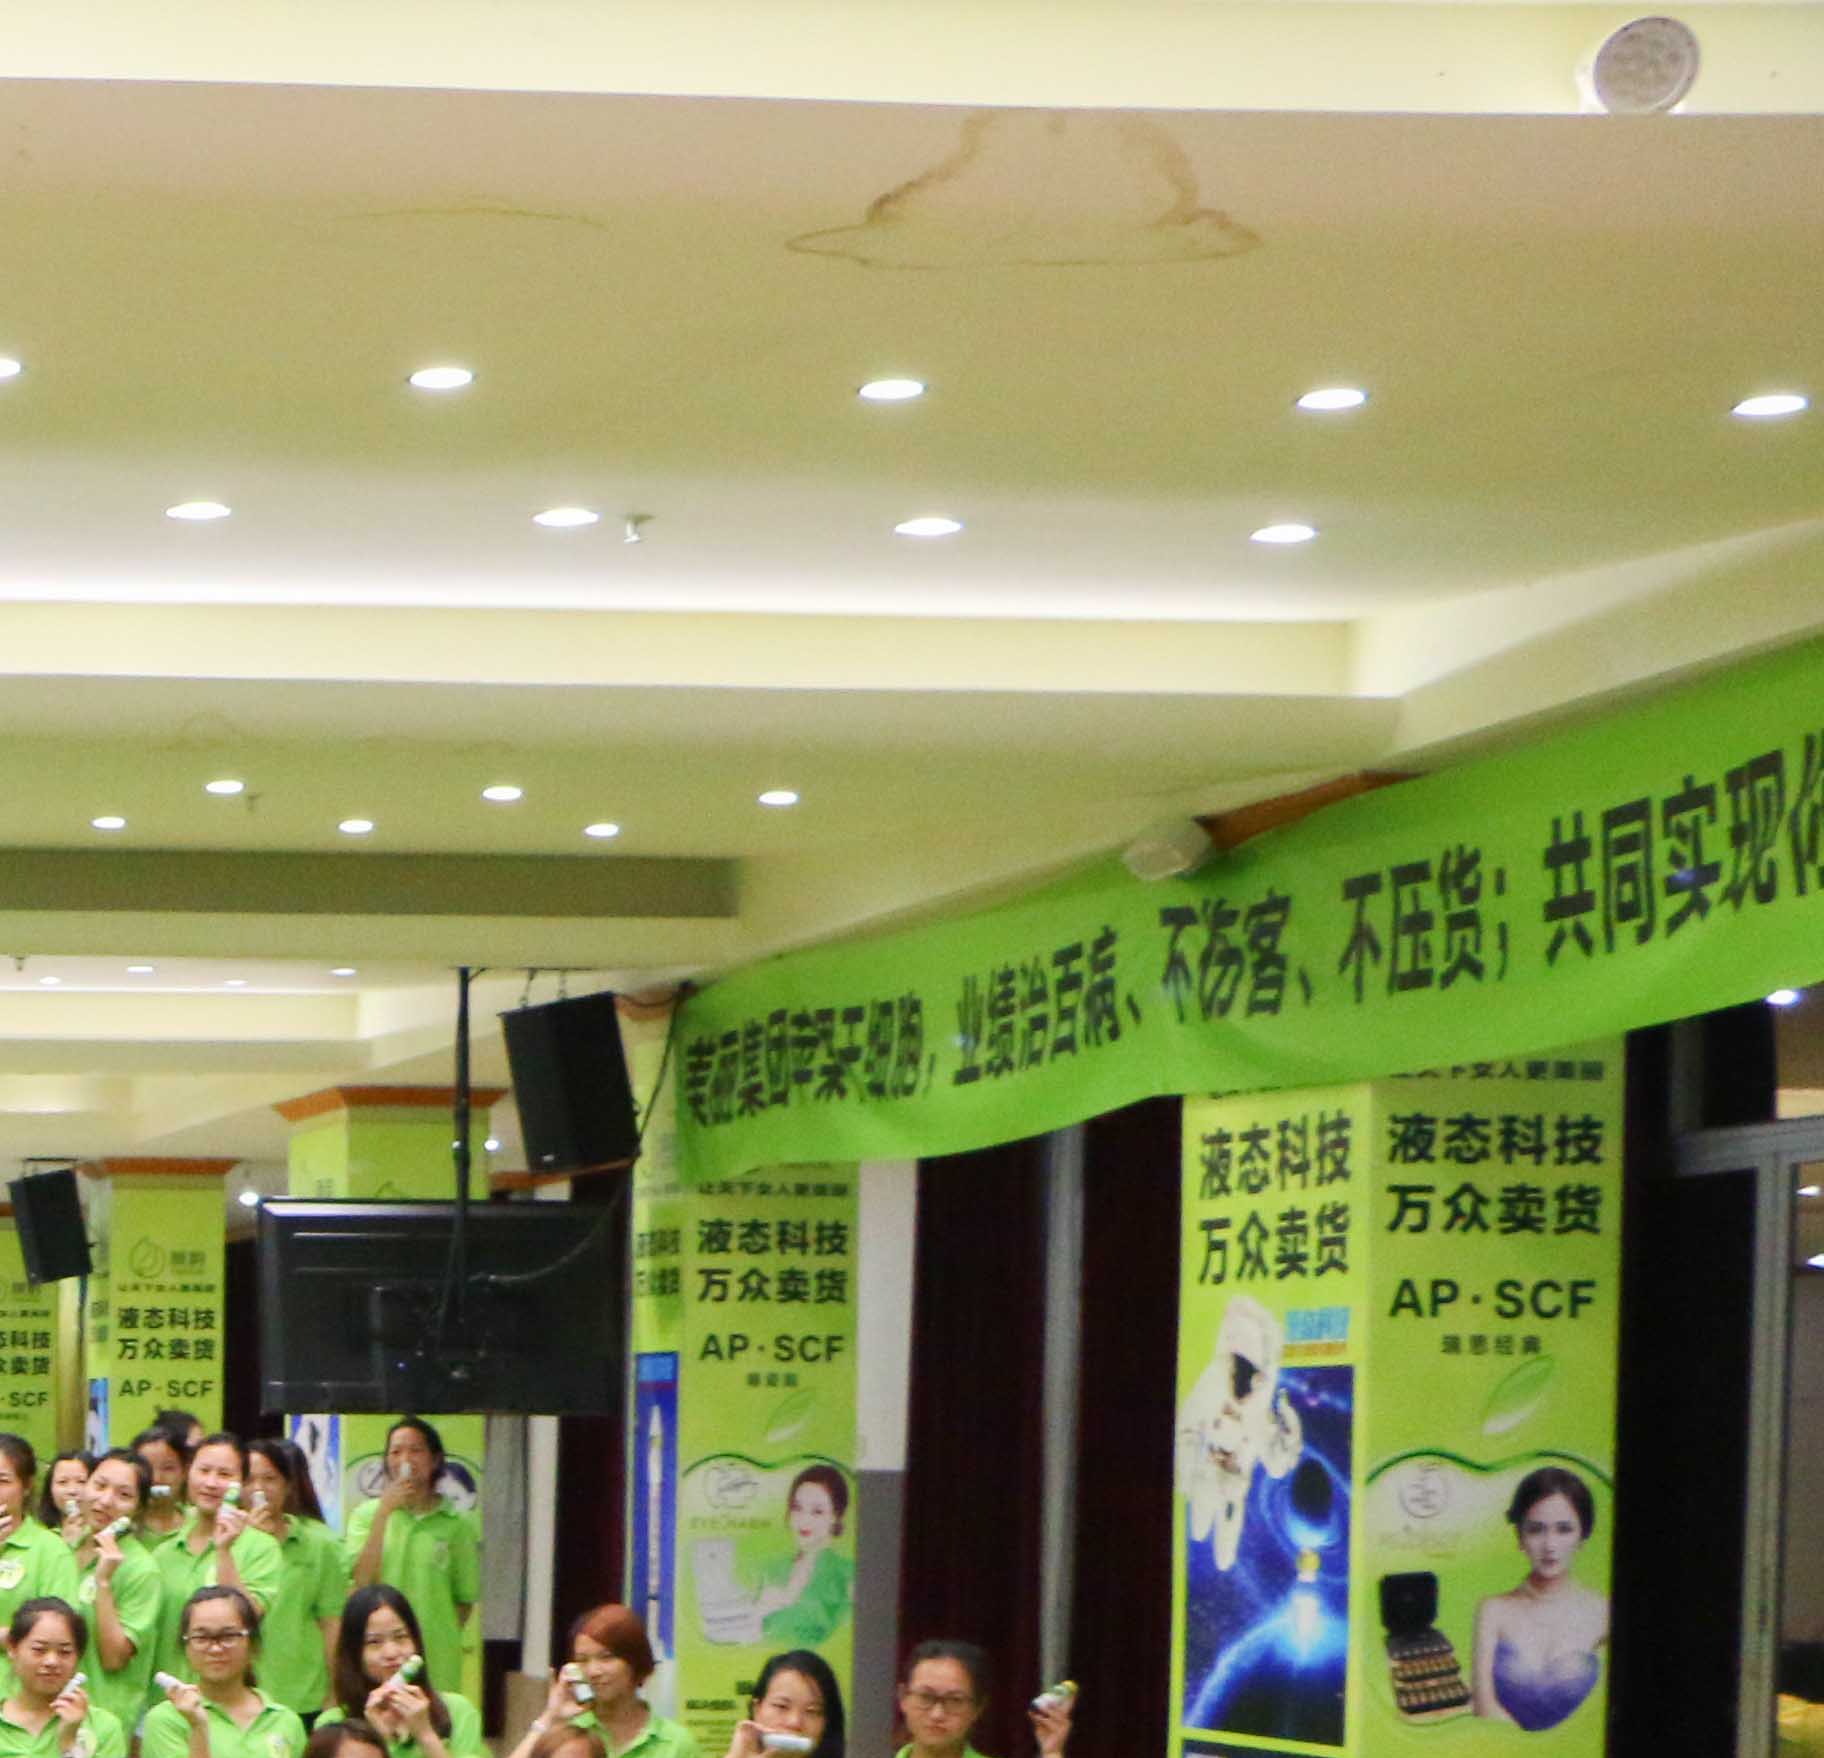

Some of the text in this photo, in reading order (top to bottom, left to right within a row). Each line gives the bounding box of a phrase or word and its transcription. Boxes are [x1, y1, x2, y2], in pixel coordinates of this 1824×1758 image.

[1200, 1110, 1351, 1199] 液态科技
[1388, 1113, 1605, 1166] 液态科技
[1387, 1184, 1601, 1234] 万众卖货
[698, 1218, 848, 1255] 液态科技
[1199, 1202, 1348, 1284] 万众卖货
[698, 1267, 848, 1304] 万众卖货
[117, 1307, 215, 1330] 液态科技
[117, 1338, 214, 1360] 万众卖货
